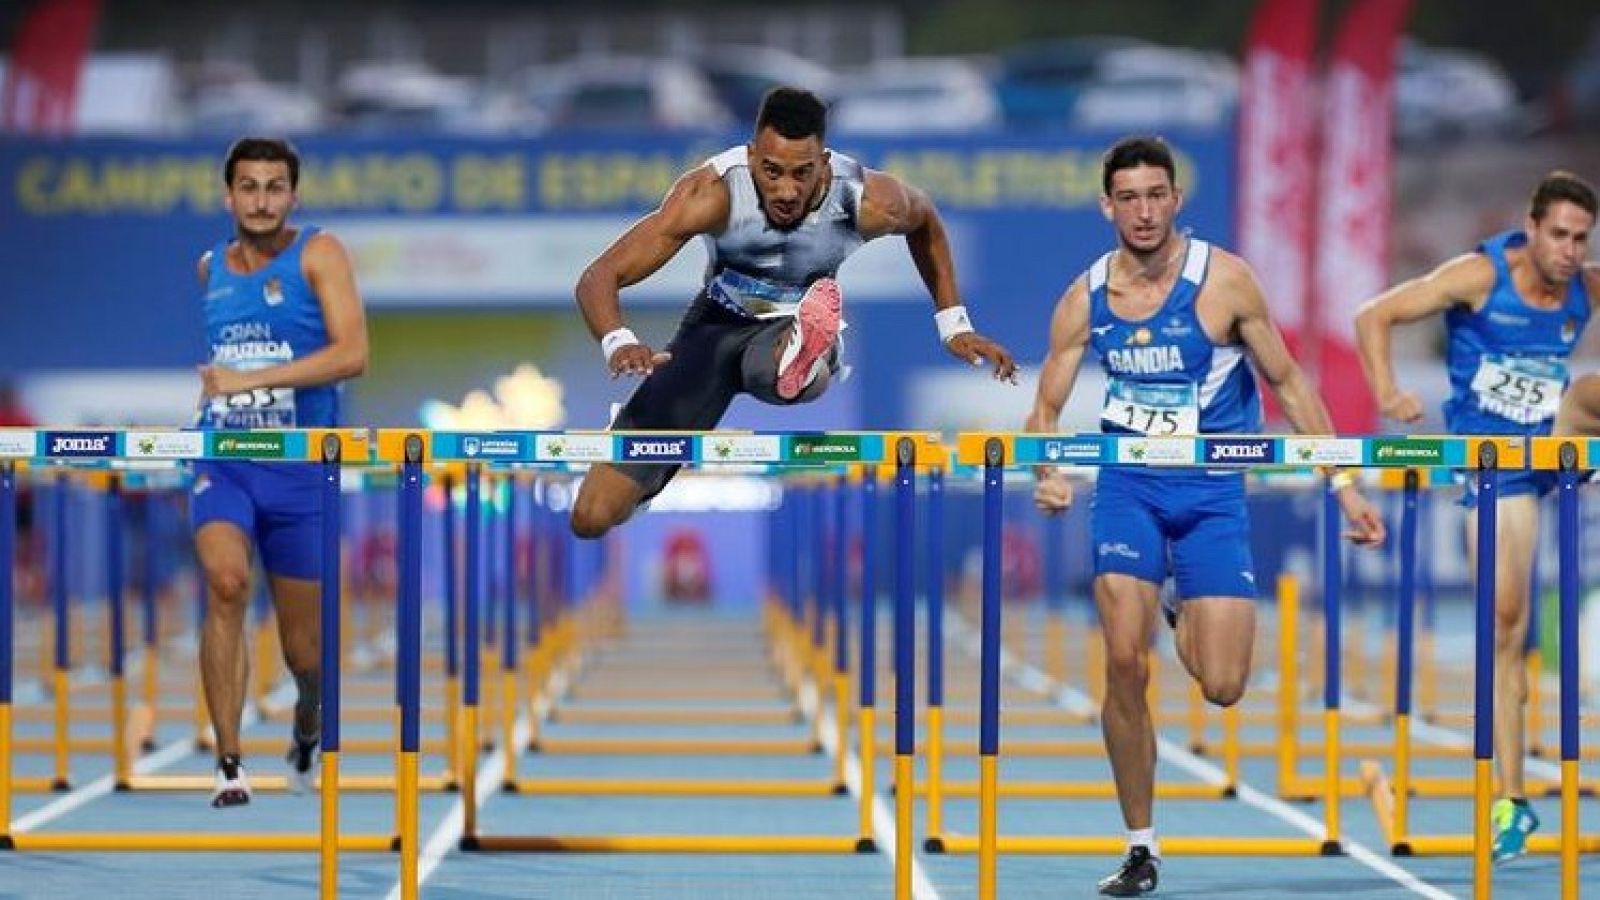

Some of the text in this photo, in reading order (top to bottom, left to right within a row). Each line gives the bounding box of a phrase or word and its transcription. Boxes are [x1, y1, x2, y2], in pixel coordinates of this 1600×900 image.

[455, 150, 523, 208] DE
[1108, 344, 1185, 374] GANDIA
[1490, 371, 1543, 404] 255
[1123, 404, 1179, 433] 175
